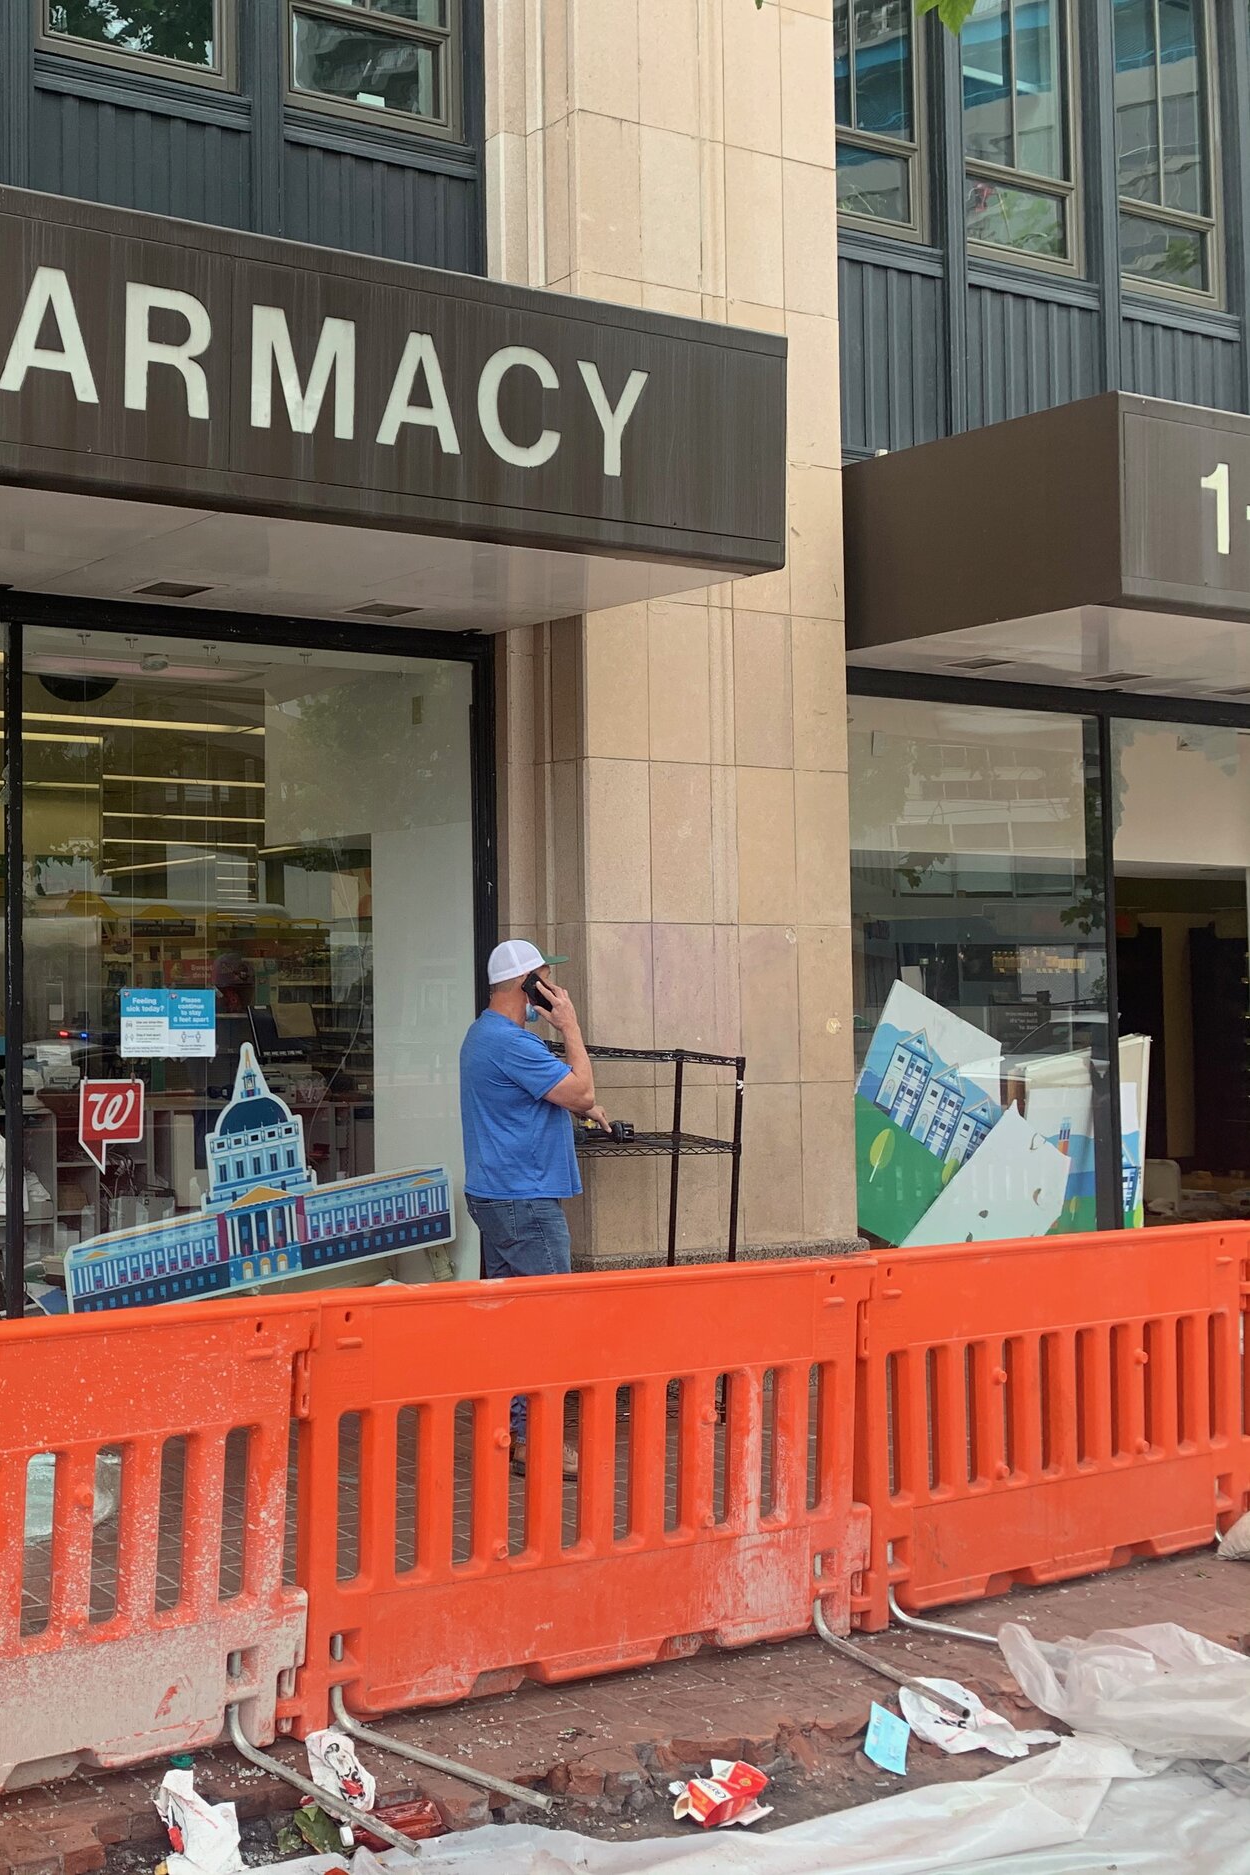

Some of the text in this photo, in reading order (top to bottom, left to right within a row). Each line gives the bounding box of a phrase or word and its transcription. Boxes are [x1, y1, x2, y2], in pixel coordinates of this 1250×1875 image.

[180, 996, 202, 1004] Please
[142, 1005, 165, 1014] today?
[192, 1016, 210, 1024] apart
